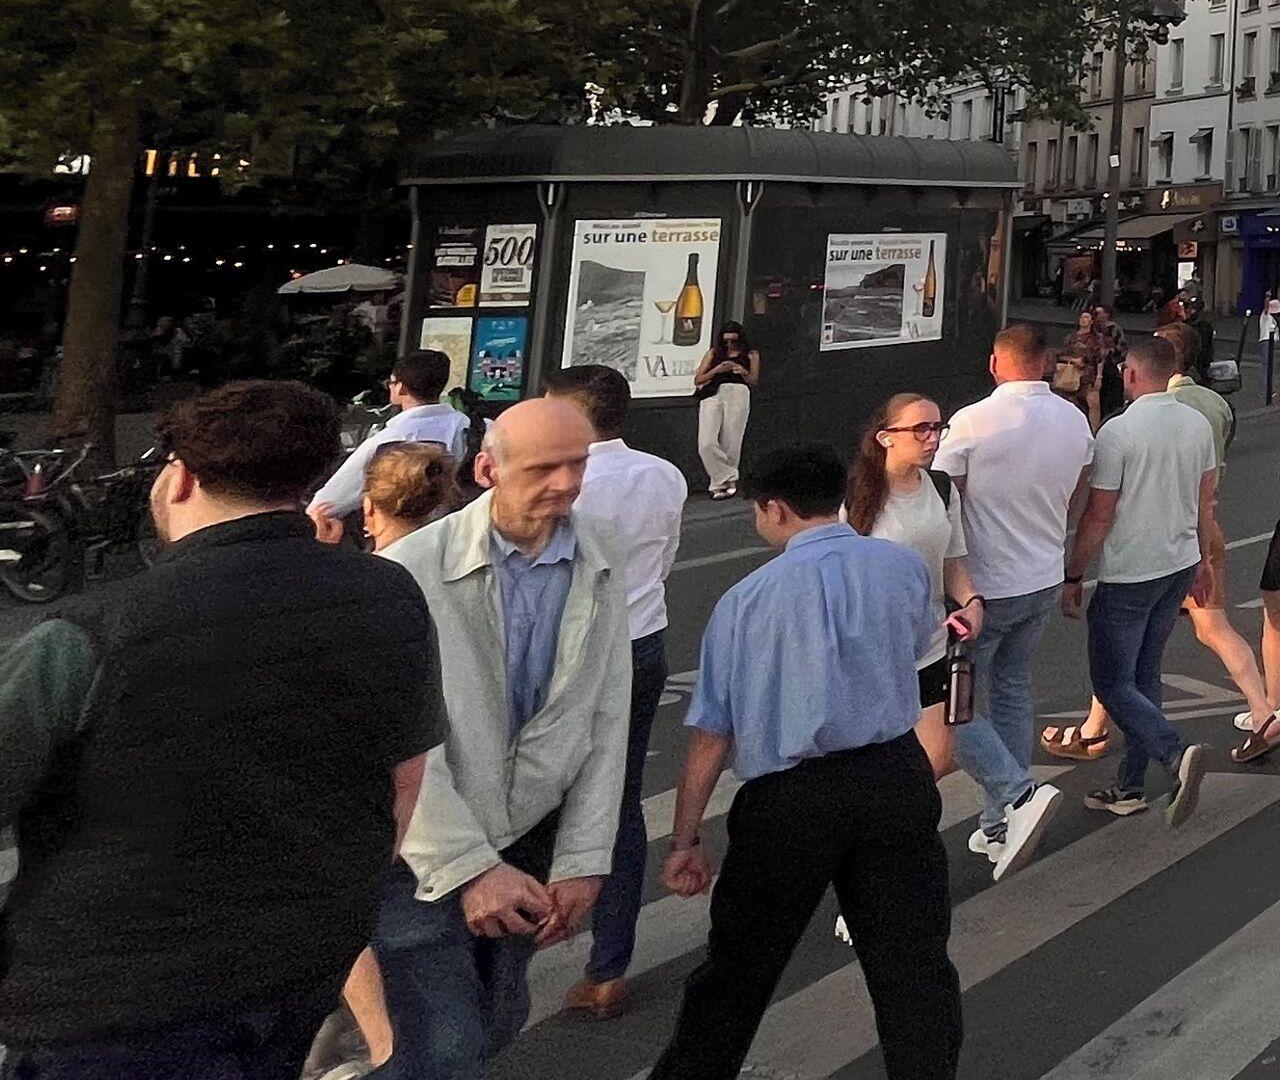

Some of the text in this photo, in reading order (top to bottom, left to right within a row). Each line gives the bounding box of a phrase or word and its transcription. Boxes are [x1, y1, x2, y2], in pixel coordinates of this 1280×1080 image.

[583, 229, 720, 245] sur une terrasse
[485, 236, 535, 267] 500
[829, 246, 921, 262] sur une terrasse
